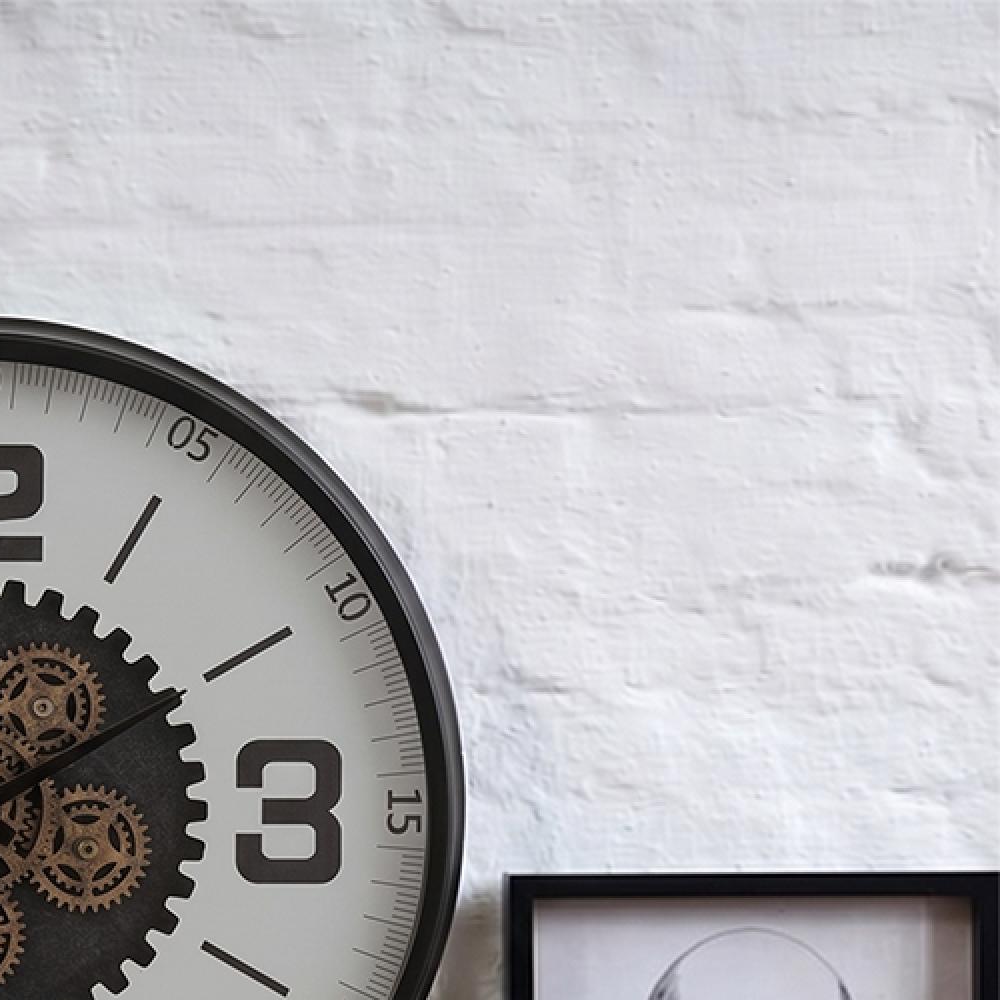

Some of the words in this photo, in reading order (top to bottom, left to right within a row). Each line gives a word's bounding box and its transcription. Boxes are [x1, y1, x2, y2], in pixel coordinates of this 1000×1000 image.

[167, 415, 219, 461] 05
[324, 571, 371, 622] 10
[236, 740, 342, 884] 3
[386, 789, 424, 834] 15
